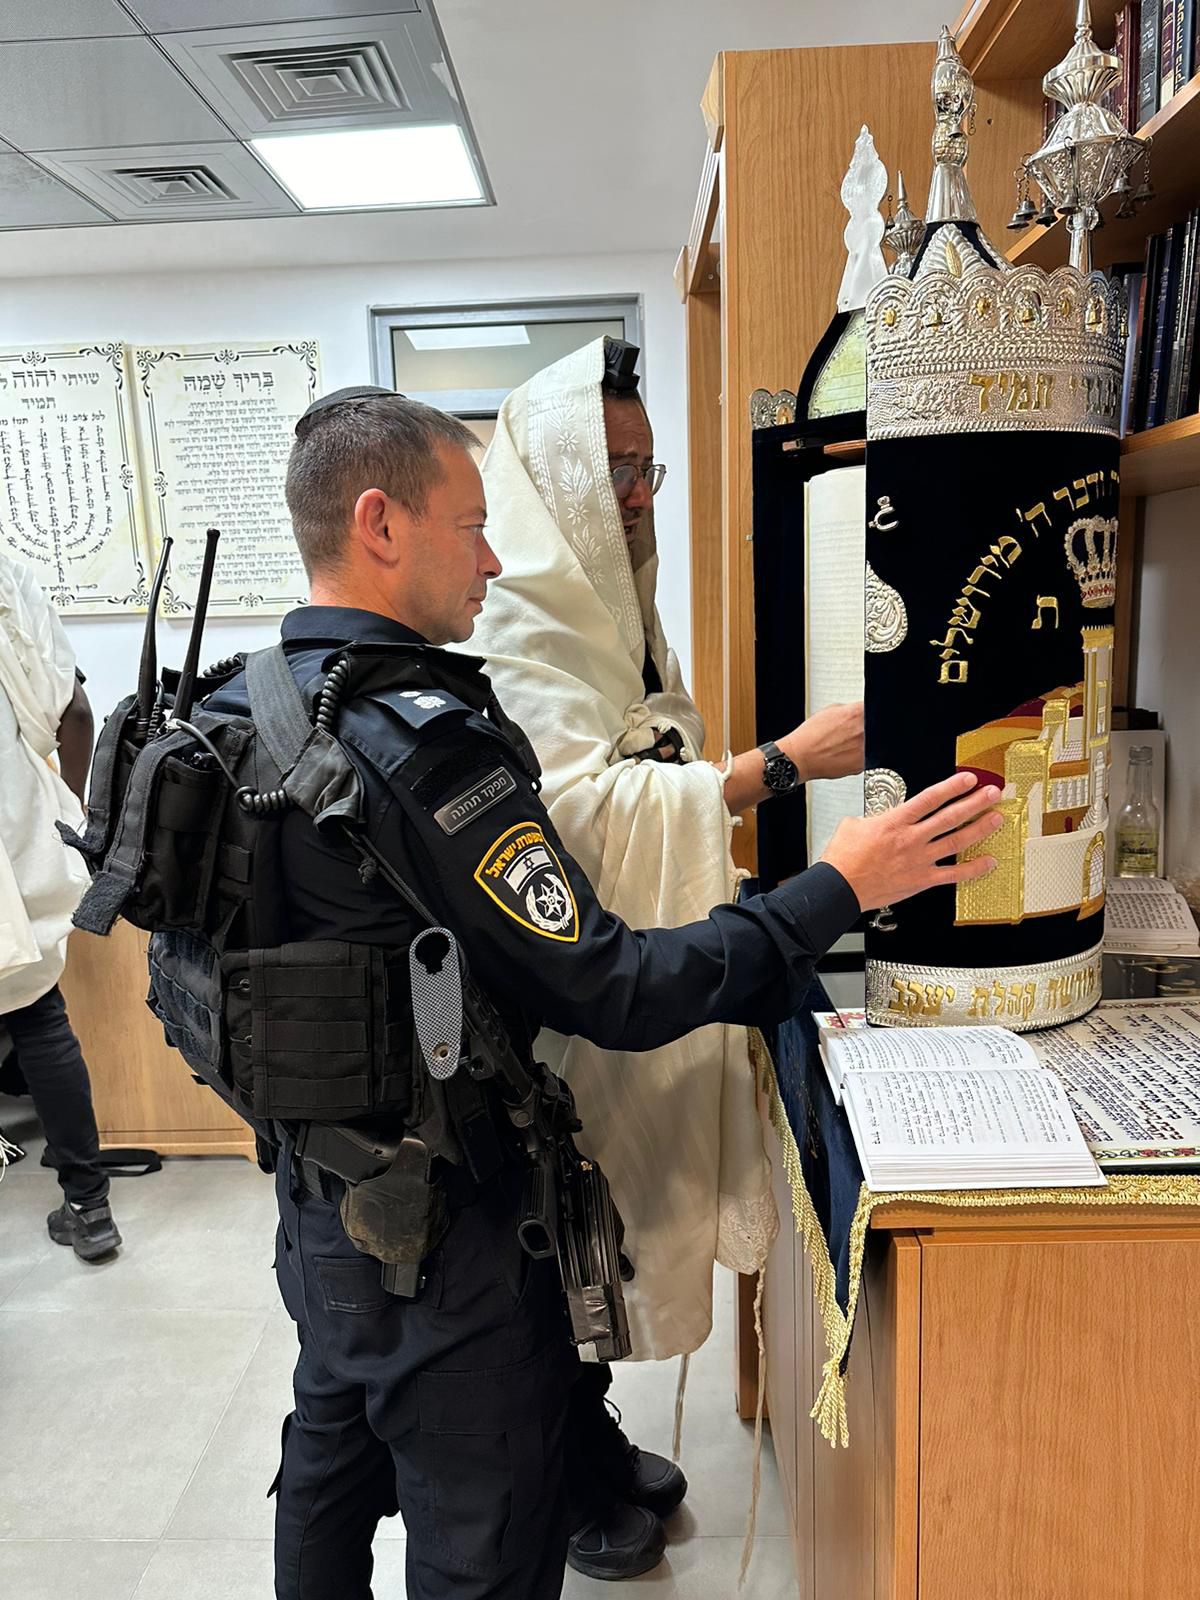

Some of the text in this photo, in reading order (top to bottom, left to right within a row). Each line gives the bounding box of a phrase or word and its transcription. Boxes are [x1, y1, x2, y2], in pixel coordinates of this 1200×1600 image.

[12, 370, 56, 389] יהוה
[62, 372, 99, 386] שויתי
[968, 372, 1055, 415] תמיד
[21, 396, 56, 410] תמיד
[1053, 470, 1104, 512] ודבר
[1031, 594, 1059, 630] ת
[451, 776, 508, 822] מפקד תחנה
[485, 831, 544, 878] משטרת ישראל
[888, 977, 956, 1020] יעקב
[967, 979, 1038, 1022] קהלת
